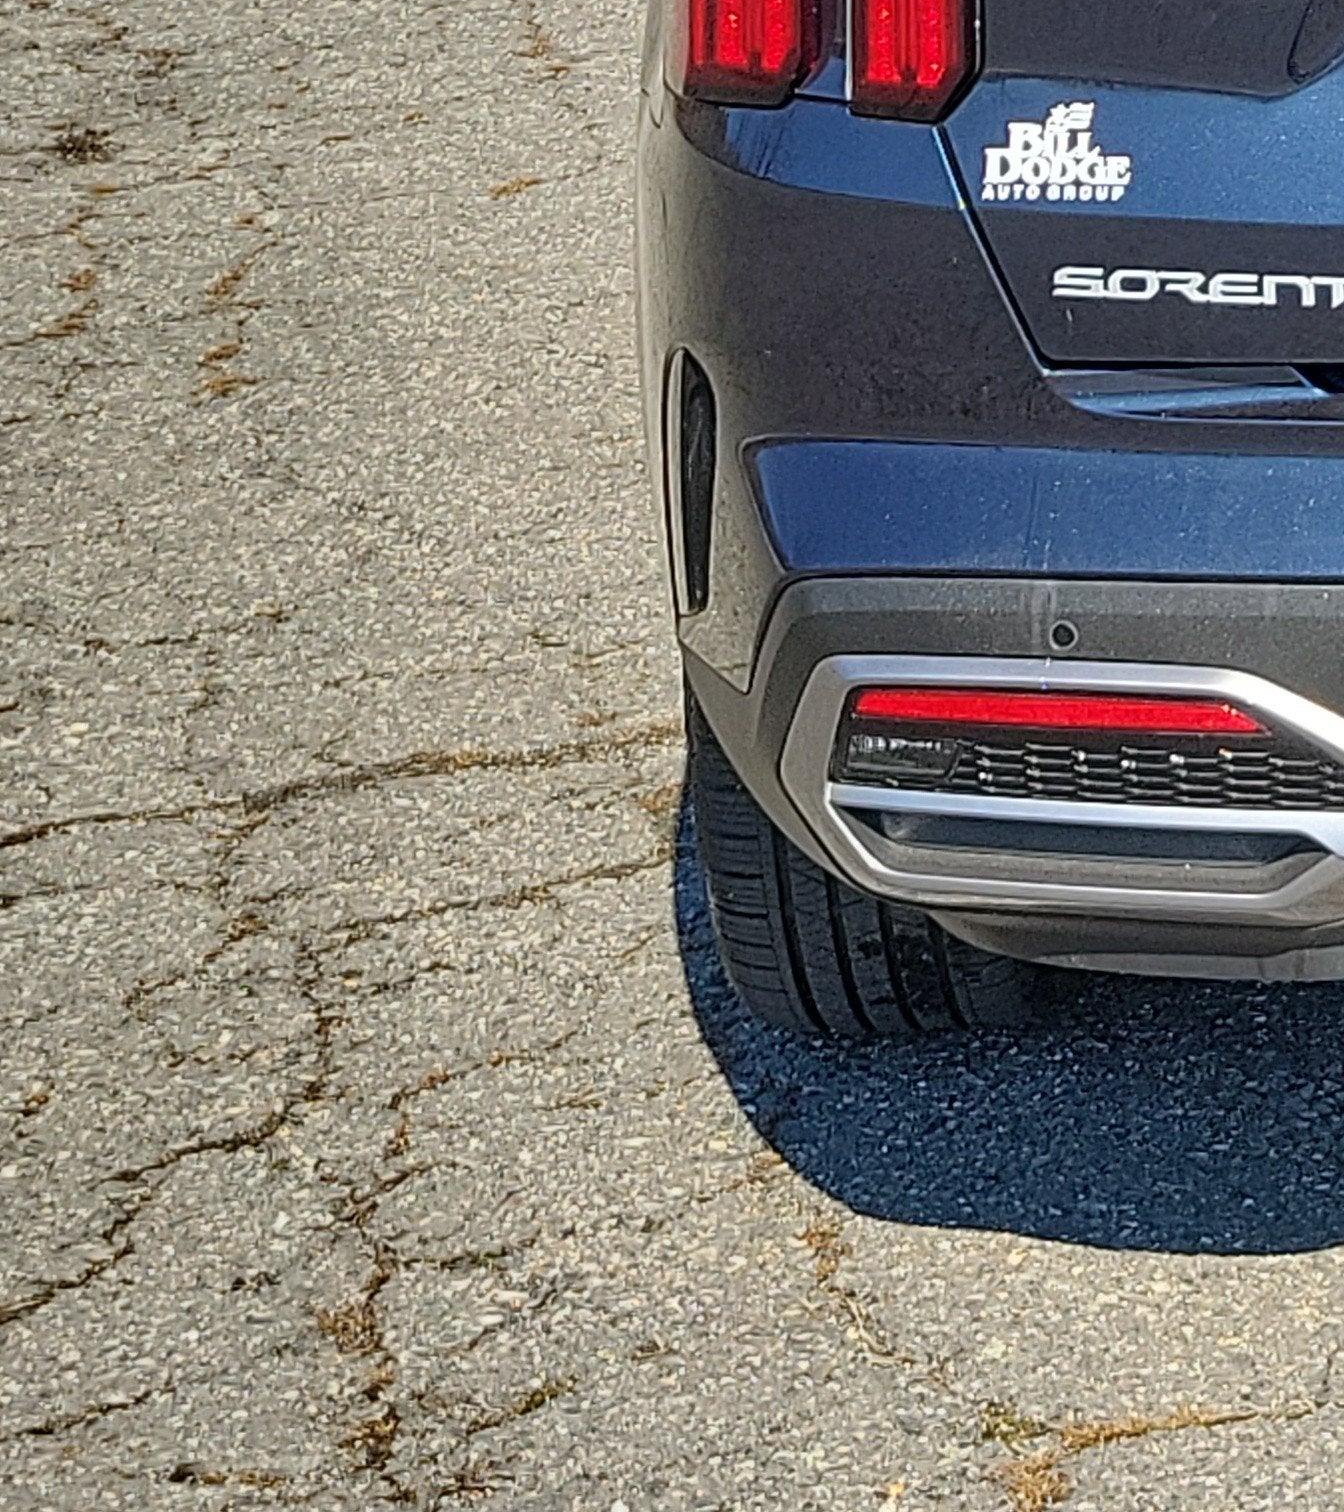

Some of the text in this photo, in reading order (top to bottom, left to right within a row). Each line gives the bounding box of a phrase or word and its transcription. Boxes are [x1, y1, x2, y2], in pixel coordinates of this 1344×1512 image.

[1007, 122, 1101, 159] BILL
[983, 148, 1132, 185] DODGE
[981, 184, 1125, 201] AUTO GROUP
